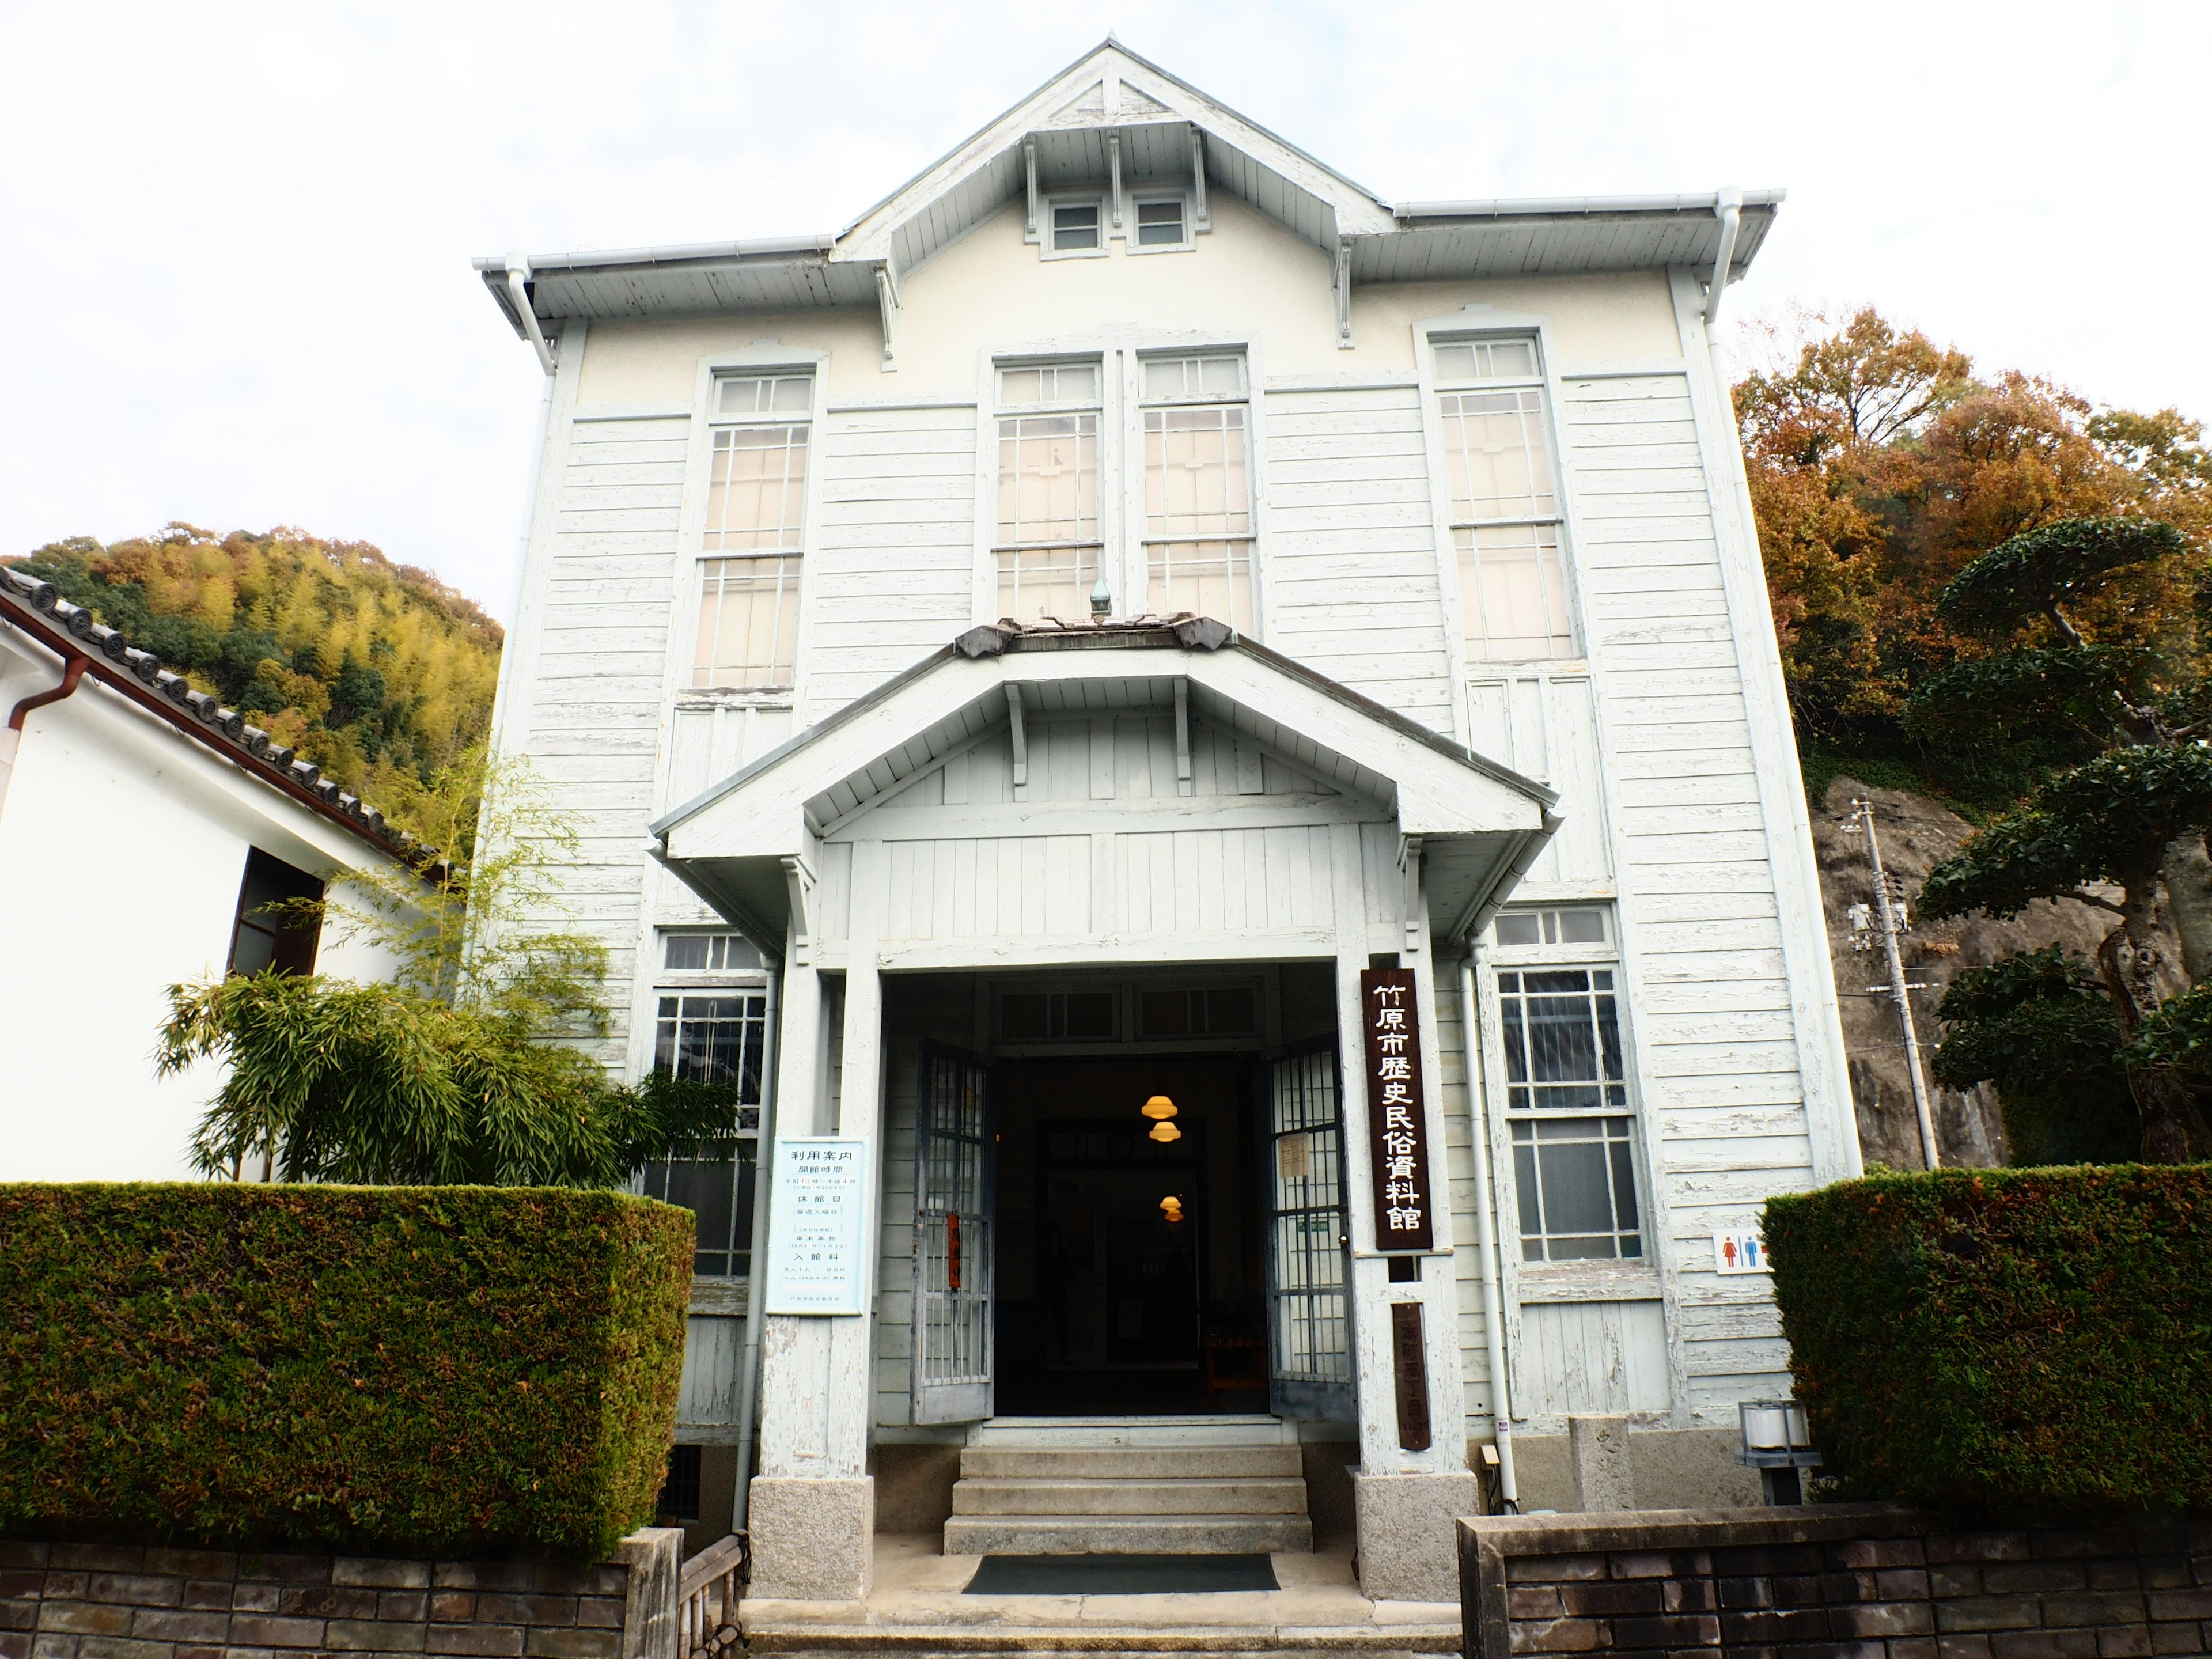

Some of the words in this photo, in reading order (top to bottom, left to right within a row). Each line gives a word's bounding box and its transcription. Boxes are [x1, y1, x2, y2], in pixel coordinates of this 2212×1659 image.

[791, 1151, 853, 1161] 利用案内
[1373, 985, 1421, 1230] 竹原市歴史民俗資料館
